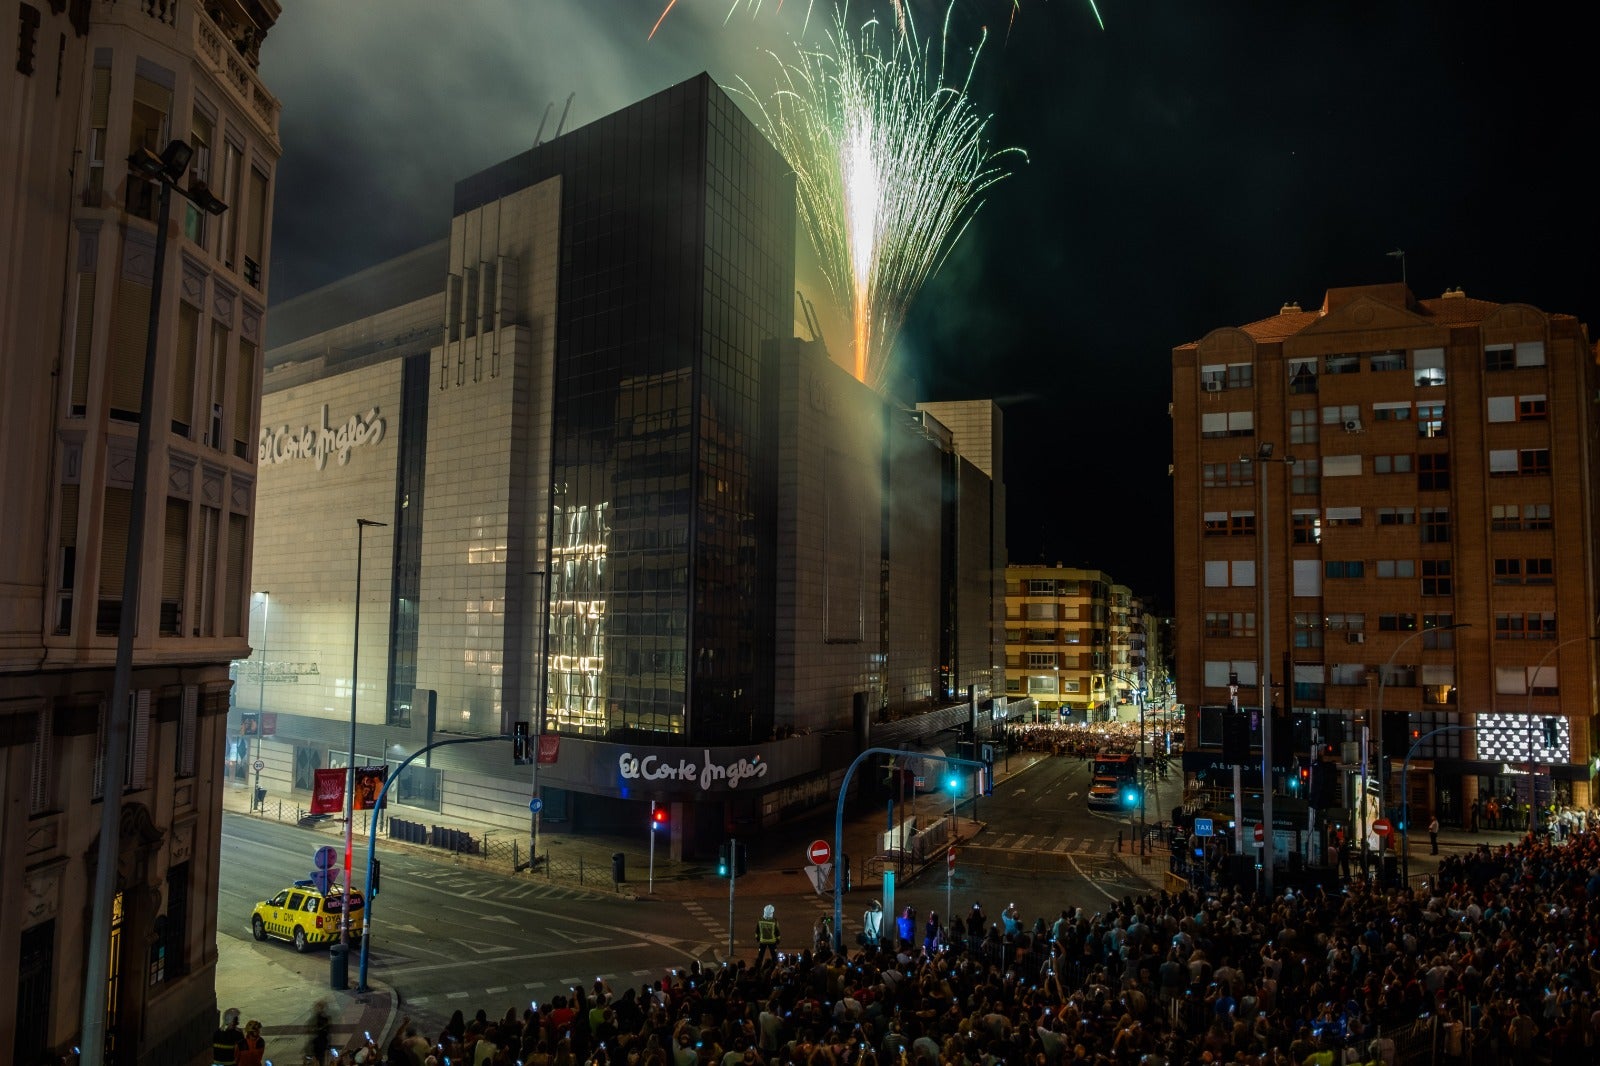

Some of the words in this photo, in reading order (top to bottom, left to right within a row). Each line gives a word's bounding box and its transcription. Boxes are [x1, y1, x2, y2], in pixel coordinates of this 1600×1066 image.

[274, 424, 317, 465] Corte
[316, 404, 387, 471] Inglés
[619, 752, 640, 779] El
[641, 755, 697, 781] Corte
[700, 749, 768, 791] Inglés
[283, 912, 294, 923] DYA
[325, 915, 341, 923] DYA
